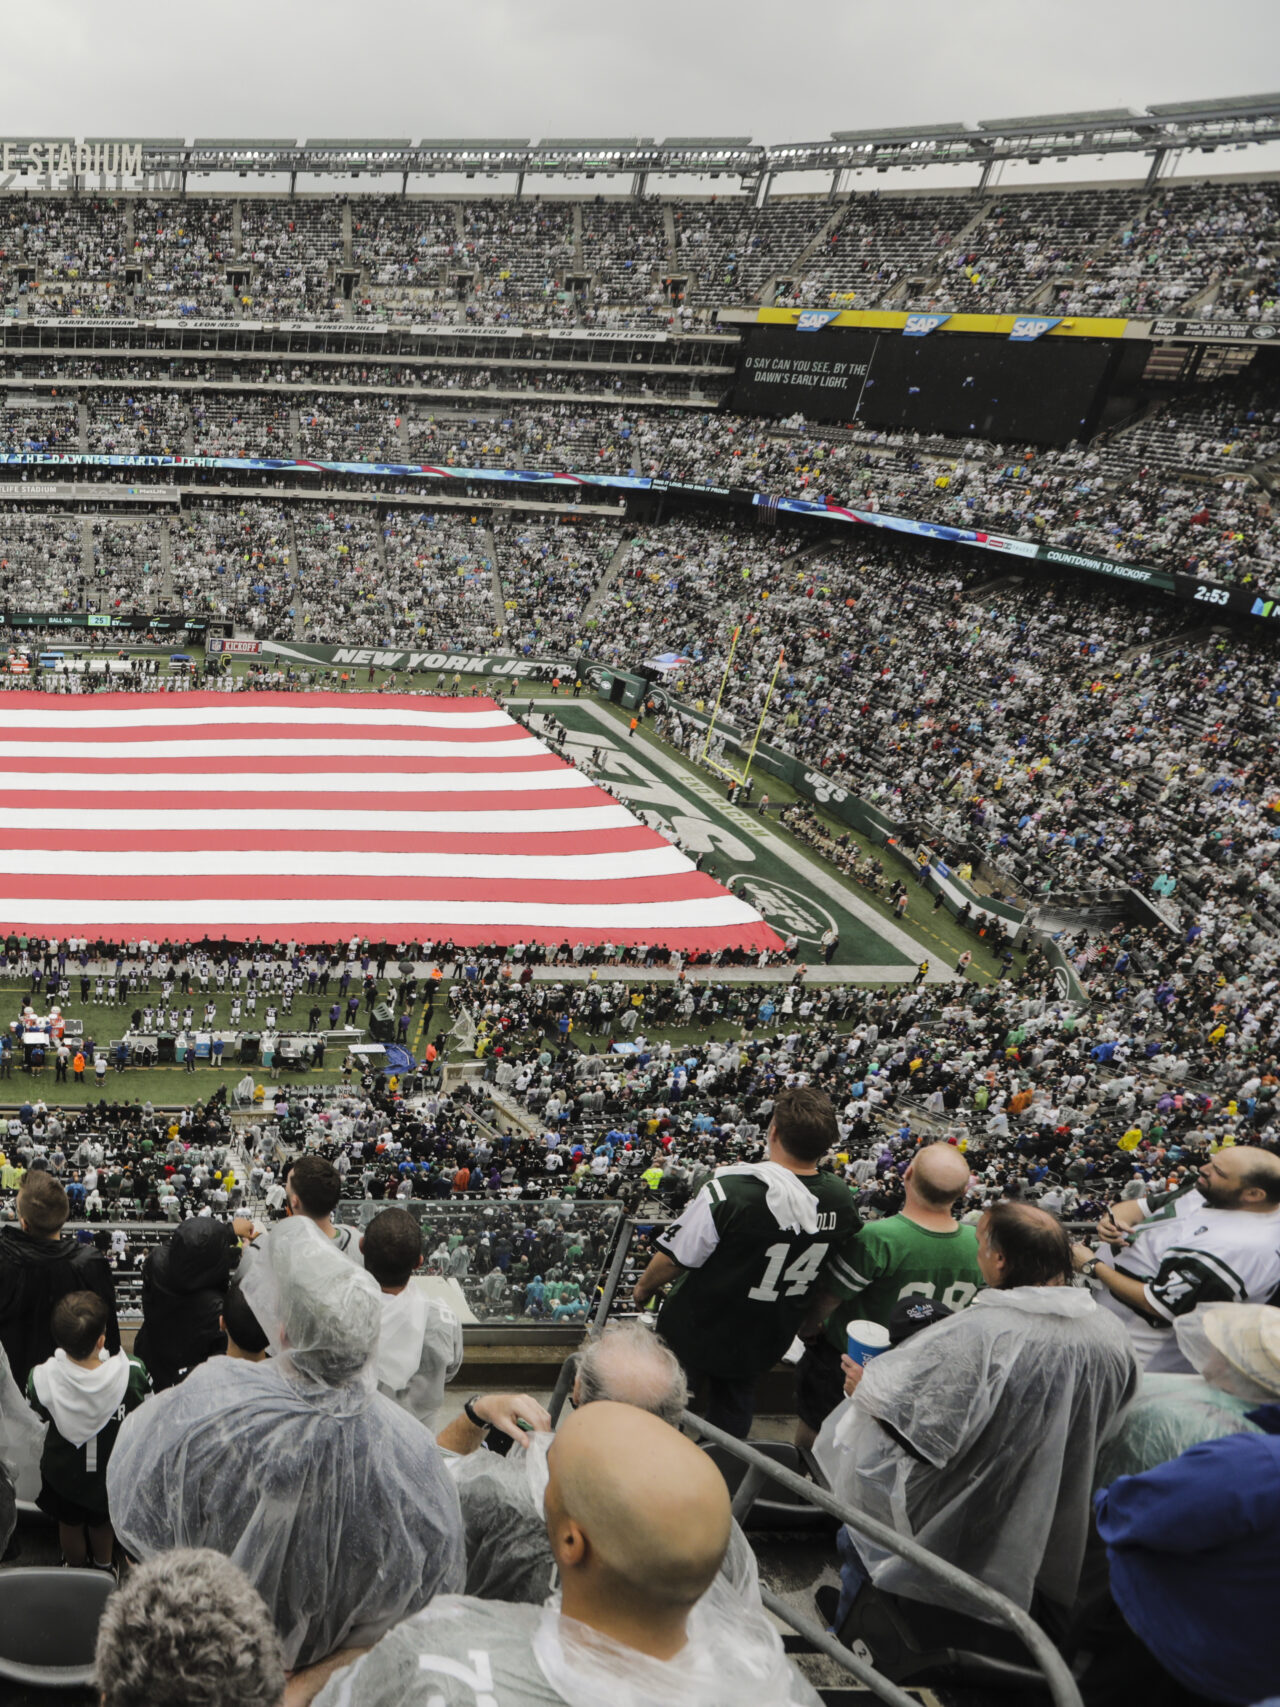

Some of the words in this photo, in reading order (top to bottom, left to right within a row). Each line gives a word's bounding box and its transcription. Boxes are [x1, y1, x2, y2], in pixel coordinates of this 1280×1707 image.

[28, 143, 143, 176] STADIUM
[797, 314, 829, 328] SAP
[905, 318, 939, 333] SAP
[1010, 321, 1048, 337] SAP
[745, 357, 753, 368] O
[753, 357, 771, 369] SAY
[771, 359, 791, 370] CAN
[792, 360, 811, 371] YOU
[811, 361, 831, 374] SEE,
[833, 362, 847, 374] BY
[848, 363, 868, 376] THE
[754, 371, 790, 384] DAWN'S
[790, 373, 820, 386] EARLY
[820, 376, 849, 389] LIGHT,
[17, 454, 43, 463] THE
[52, 454, 110, 464] DAWN'S
[118, 455, 165, 466] EARLY
[21, 485, 57, 493] STADIUM
[1047, 550, 1100, 571] COUNTDOWN
[1101, 561, 1114, 573] TO
[1114, 566, 1152, 582] KICKOFF
[1194, 586, 1231, 606] 2:53
[225, 641, 257, 651] KICKOFF
[332, 649, 403, 666] NEW
[407, 653, 491, 675] YORK
[804, 772, 849, 802] JETS
[679, 774, 709, 796] END
[712, 796, 772, 838] RACISM
[748, 1242, 830, 1302] 14
[1153, 1270, 1193, 1305] 74
[858, 1647, 868, 1658] 2
